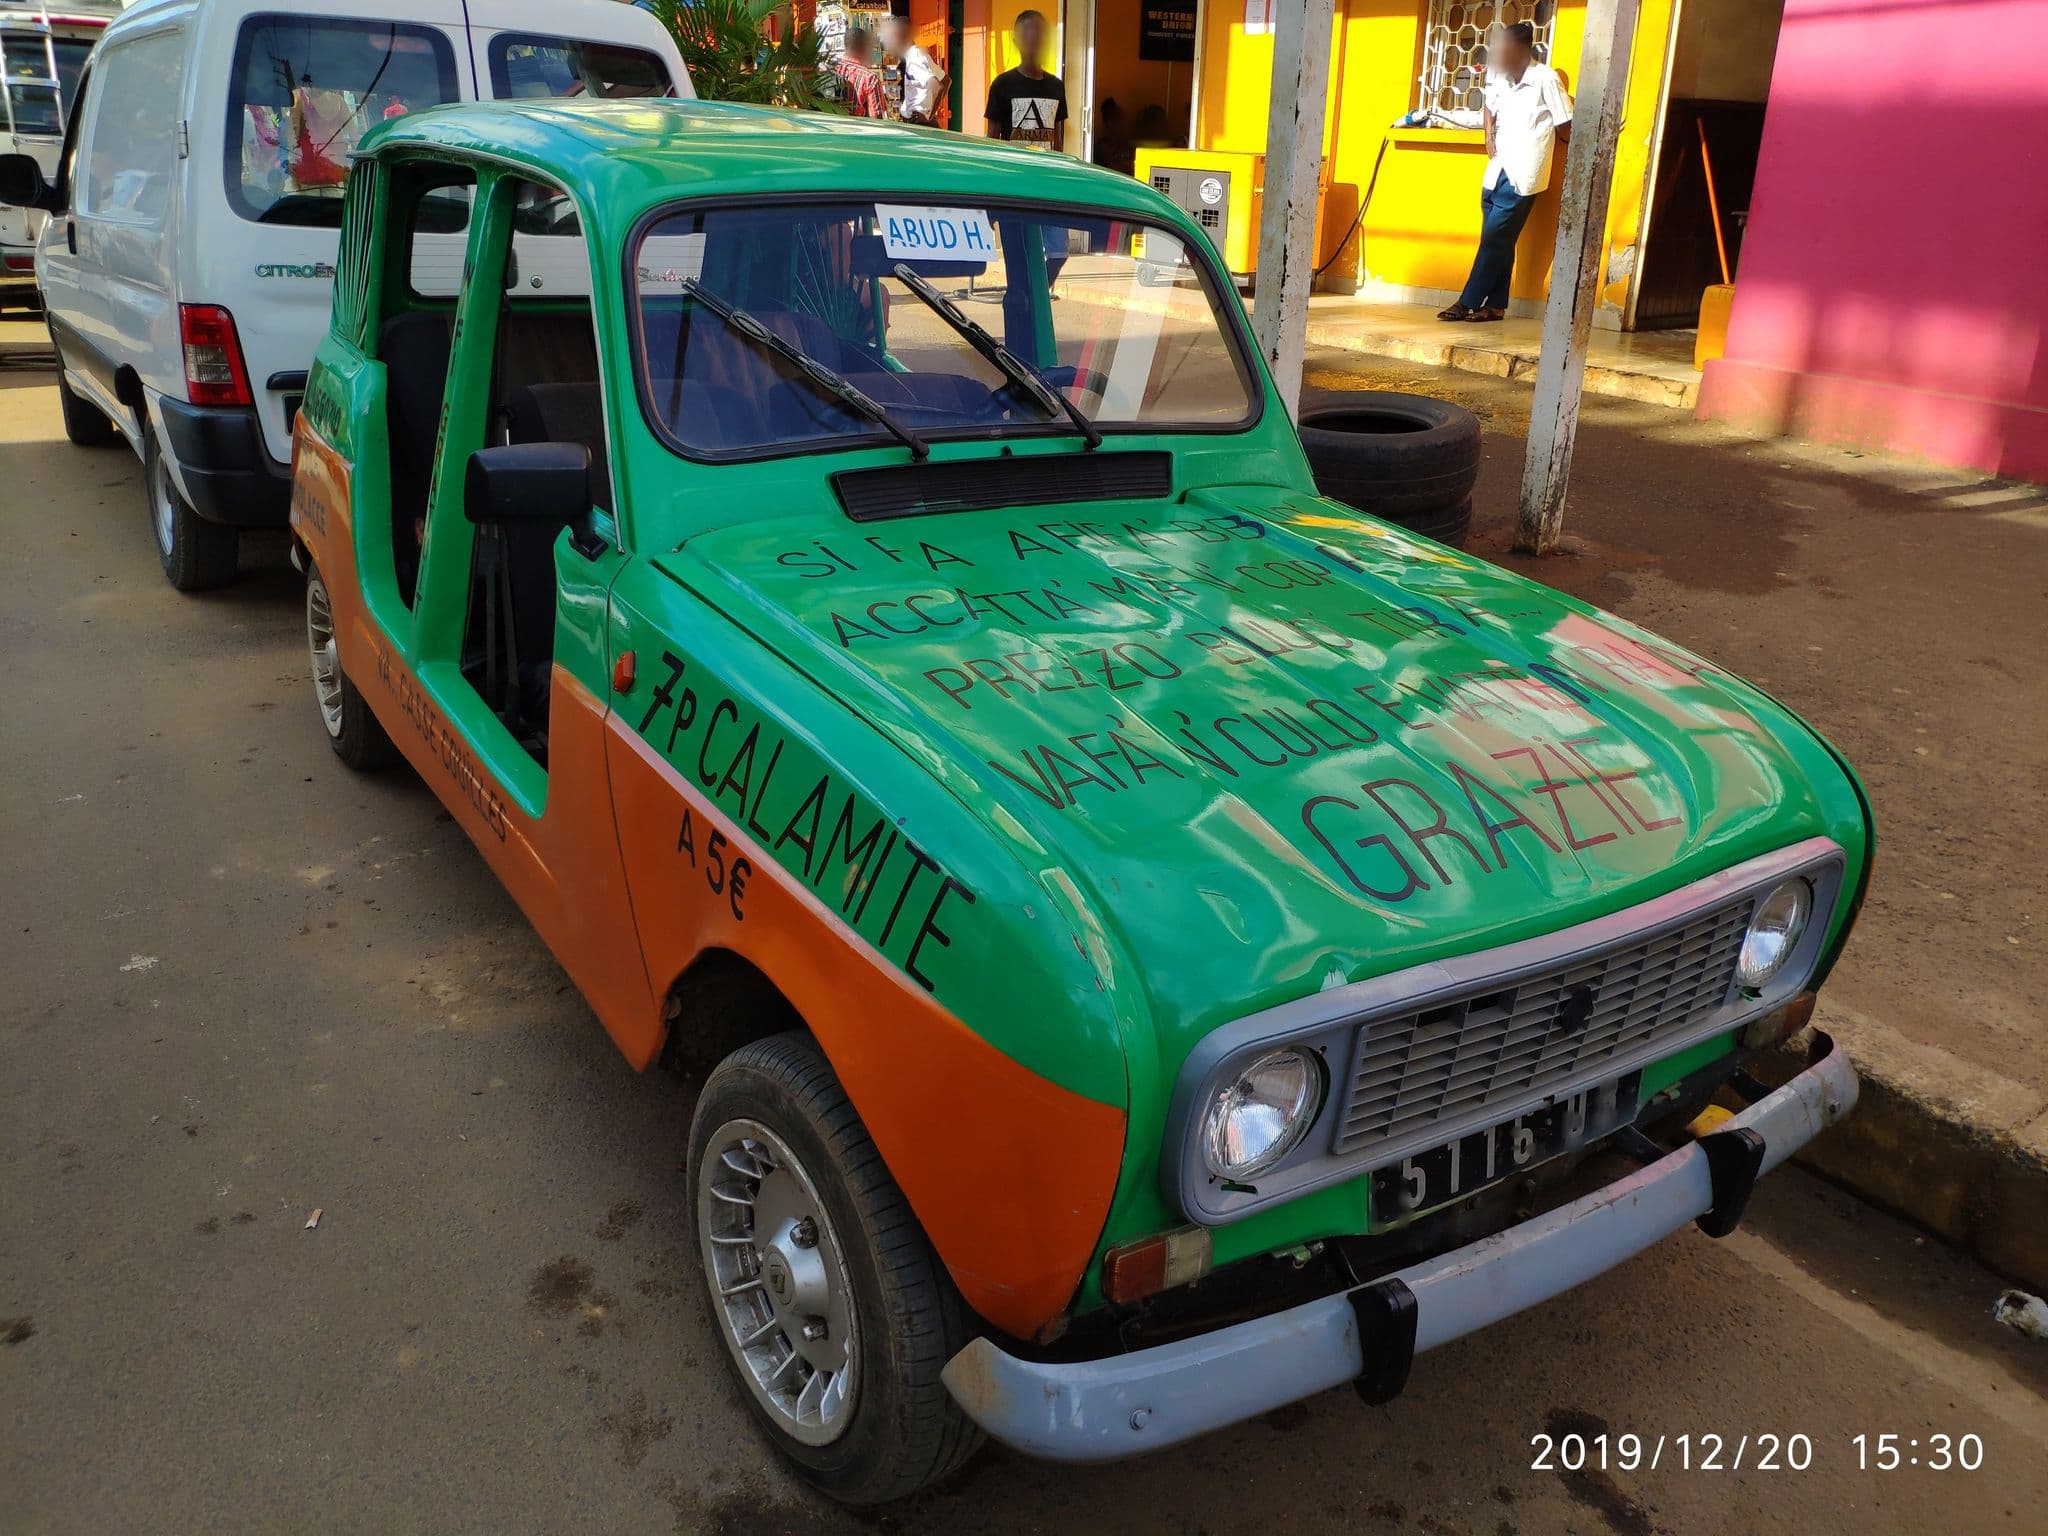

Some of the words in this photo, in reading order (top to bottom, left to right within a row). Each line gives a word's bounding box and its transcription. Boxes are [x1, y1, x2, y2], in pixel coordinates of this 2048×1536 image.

[1148, 11, 1193, 20] WESTERN
[1162, 21, 1193, 29] UNION
[1016, 99, 1044, 129] A
[888, 216, 957, 248] ABUD
[963, 220, 992, 251] H.
[1301, 736, 1684, 902] GRAZIE
